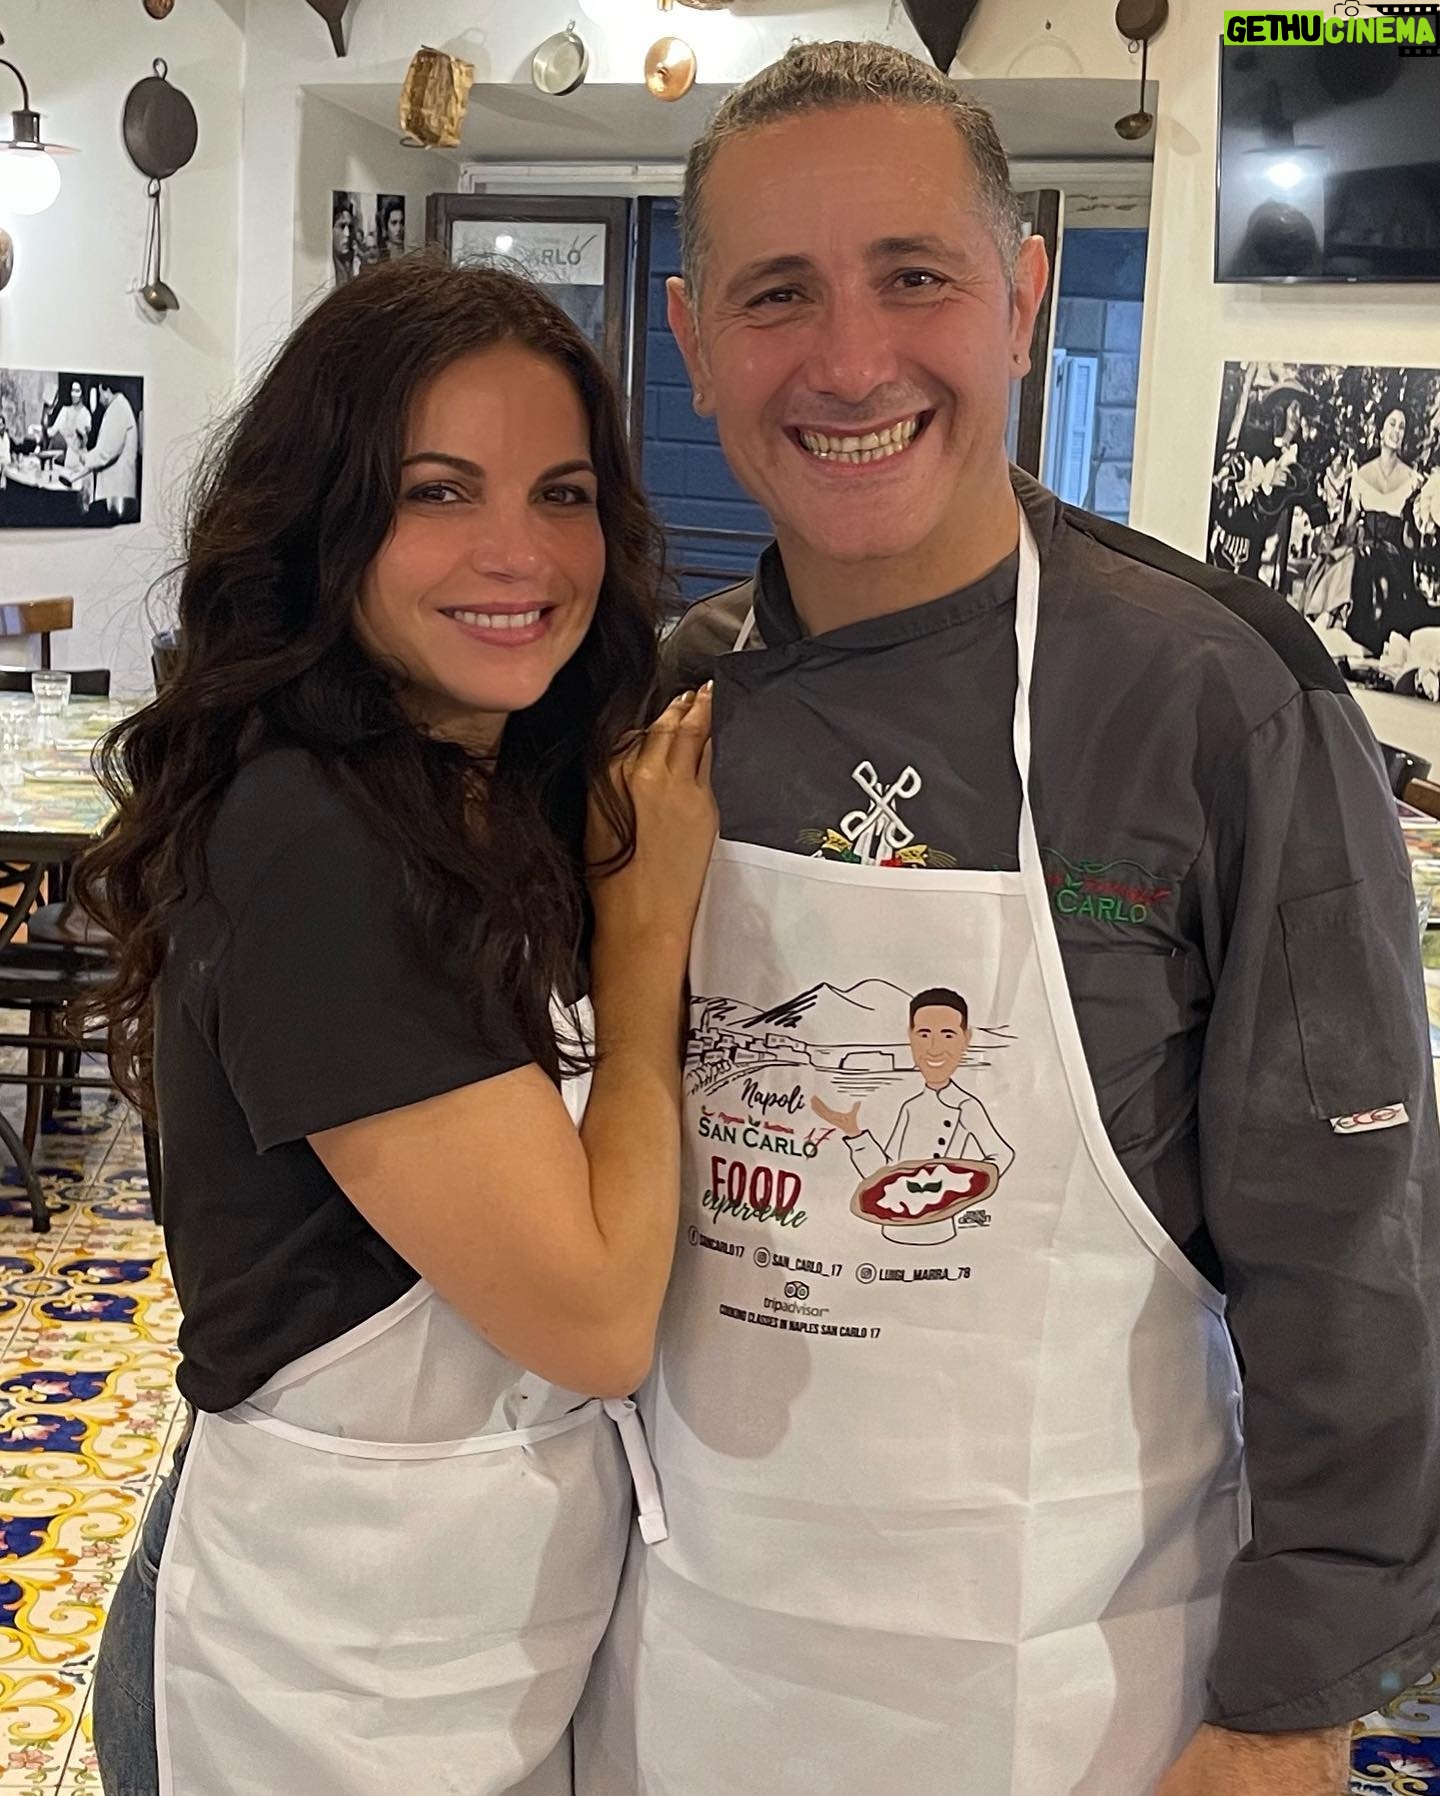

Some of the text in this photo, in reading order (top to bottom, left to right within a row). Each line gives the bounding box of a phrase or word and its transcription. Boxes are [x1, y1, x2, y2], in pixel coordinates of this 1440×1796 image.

[1056, 888, 1147, 923] CARLO
[740, 1077, 806, 1116] Napoli
[698, 1116, 736, 1144] SAN
[742, 1127, 819, 1159] CARLO
[711, 1155, 802, 1217] FOOD
[821, 1324, 838, 1336] SAN
[839, 1325, 868, 1339] CARLO
[870, 1327, 881, 1339] 17
